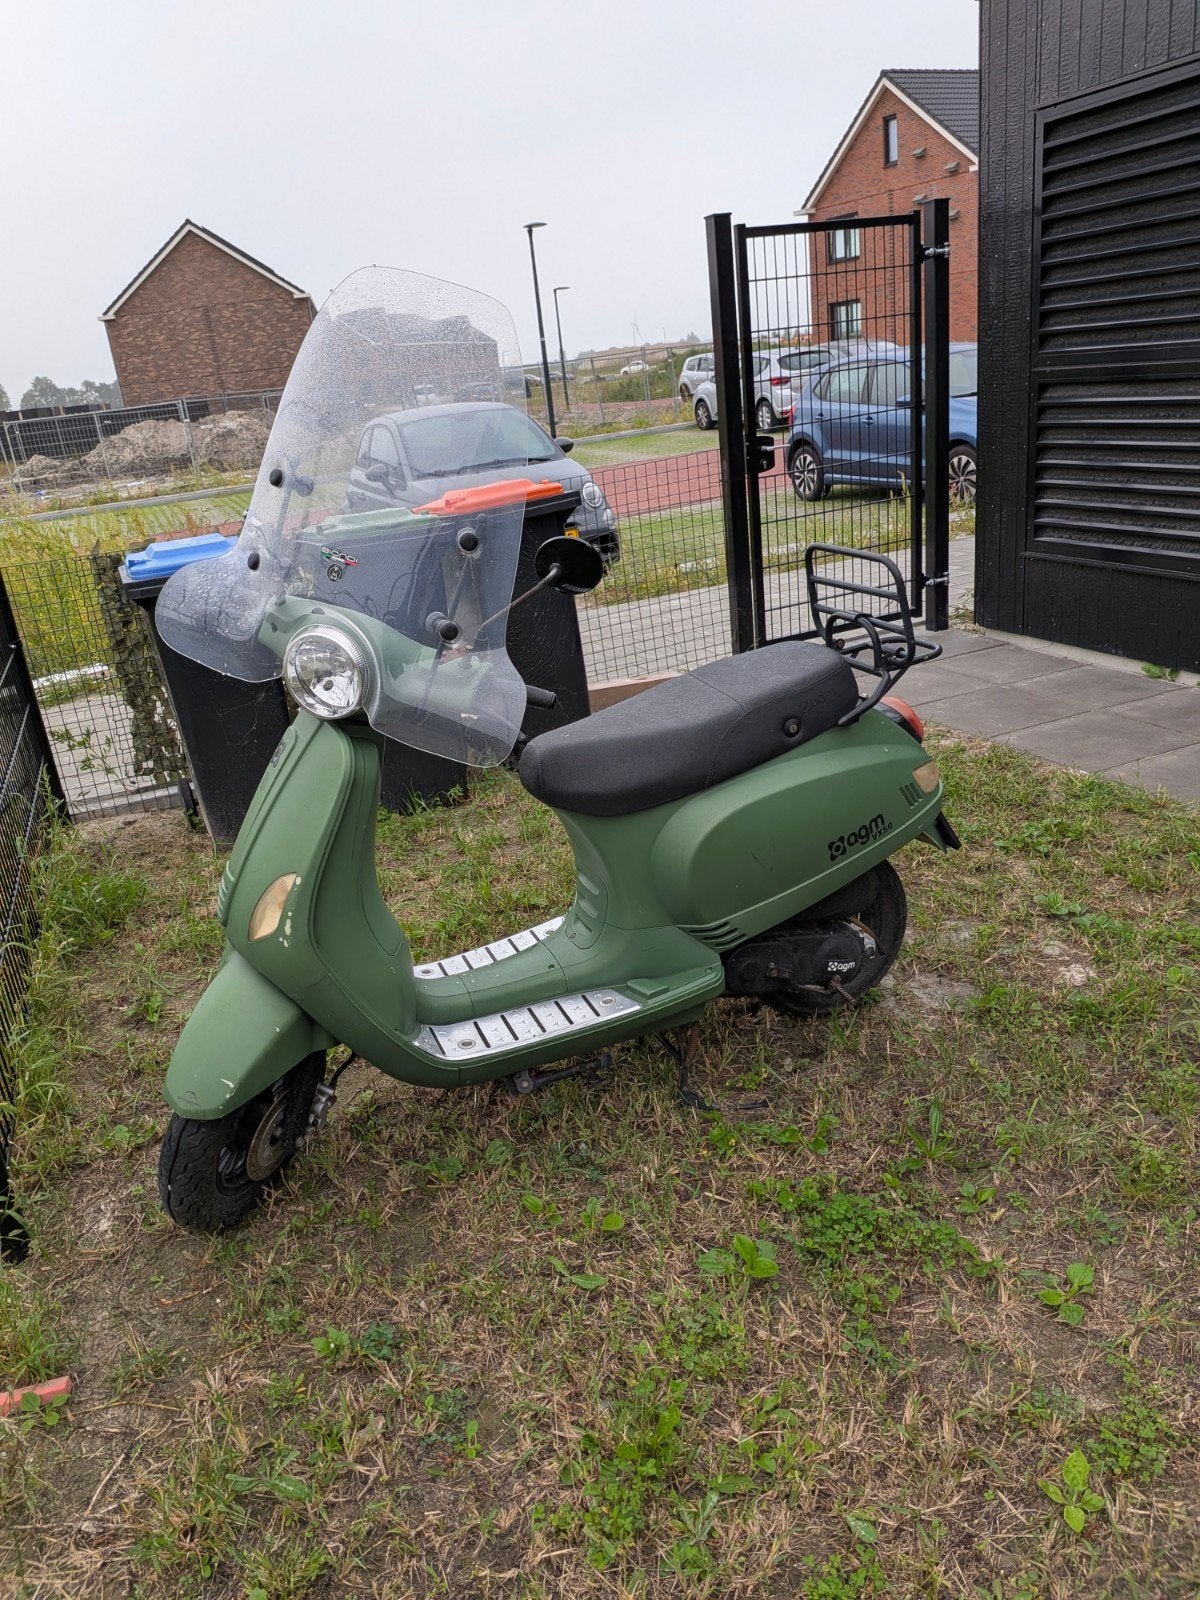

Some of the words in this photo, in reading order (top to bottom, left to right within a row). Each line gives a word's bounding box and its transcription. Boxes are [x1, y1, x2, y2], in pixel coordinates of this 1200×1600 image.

[846, 813, 886, 846] agm
[871, 822, 893, 841] VX50
[837, 961, 856, 972] agm
